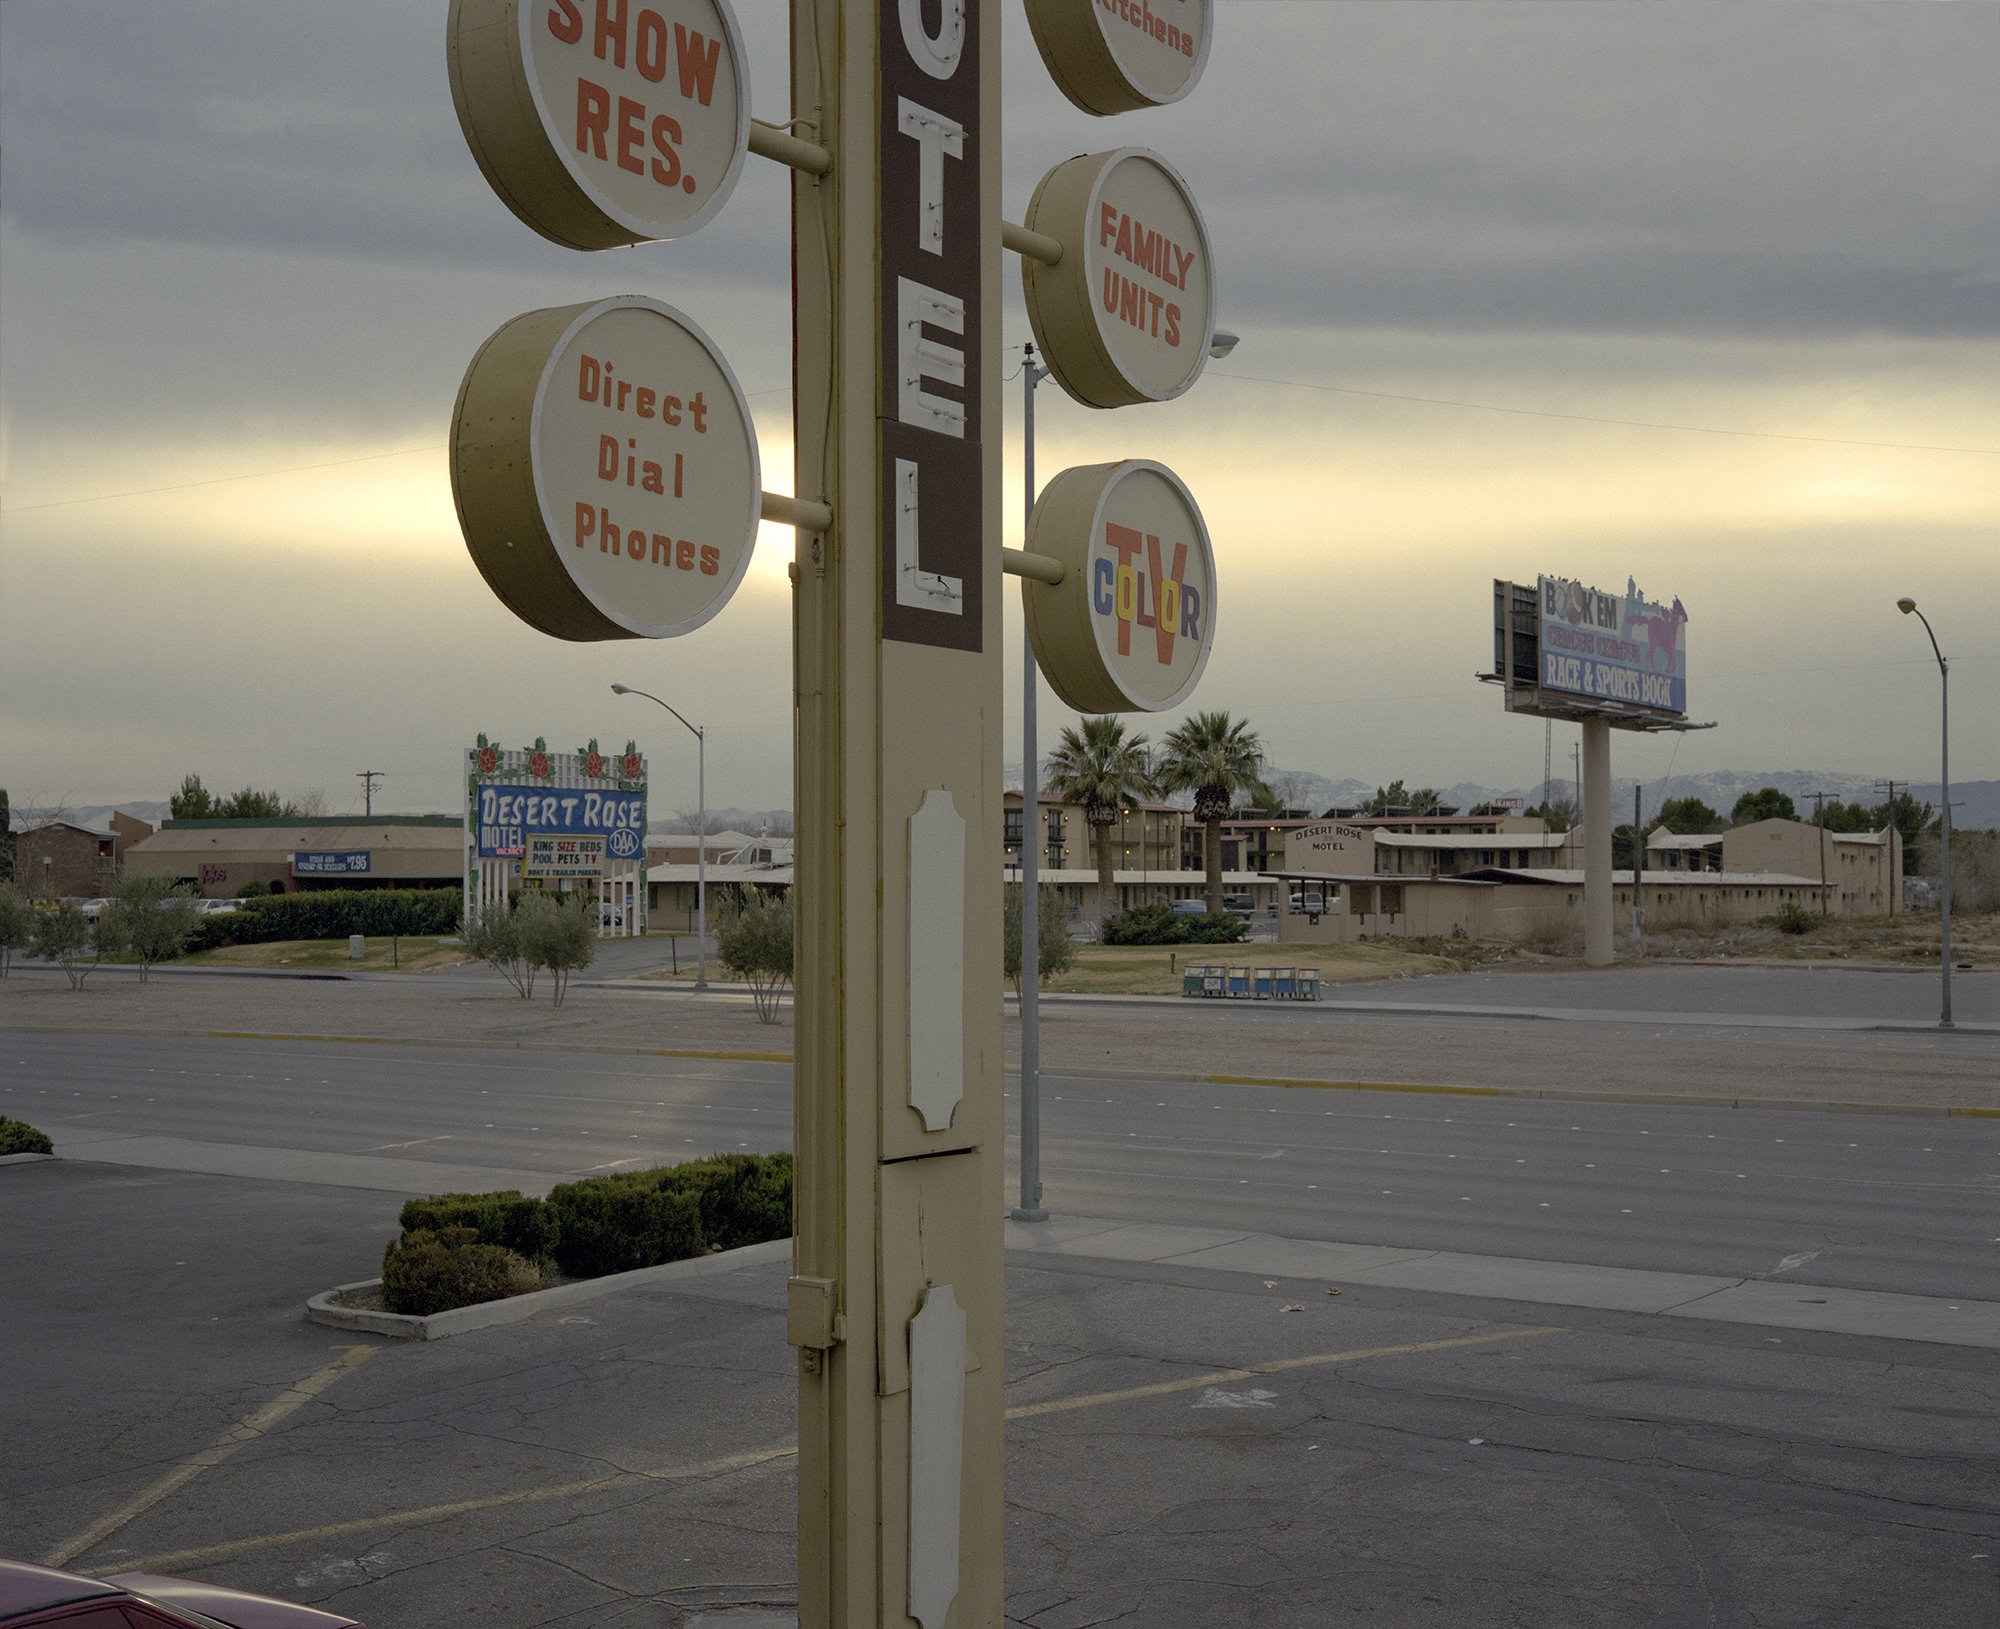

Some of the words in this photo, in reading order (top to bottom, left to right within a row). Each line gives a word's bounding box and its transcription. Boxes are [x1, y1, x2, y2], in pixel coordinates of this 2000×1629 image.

[548, 0, 721, 106] SHOW
[1098, 0, 1194, 58] tchens
[576, 77, 696, 194] RES.
[1100, 201, 1195, 291] FAMILY
[1103, 266, 1181, 348] UNITS
[579, 354, 707, 433] Direct
[598, 434, 683, 498] Dial
[575, 502, 720, 576] Phones
[1094, 557, 1199, 641] COLOR
[1106, 522, 1188, 665] TV
[1546, 654, 1580, 690] RACE
[1584, 661, 1594, 692] &
[1596, 664, 1640, 701] SPORTS
[481, 826, 526, 849] MOTEL
[482, 788, 579, 827] DESERT
[583, 792, 642, 828] ROSE
[1295, 825, 1333, 840] DESERT
[1336, 826, 1362, 840] ROSE
[532, 854, 553, 864] POOL
[558, 854, 580, 864] PETS
[533, 841, 554, 852] KING
[557, 841, 576, 852] SIZE
[580, 842, 602, 852] BEDS
[1312, 843, 1344, 851] MOTEL
